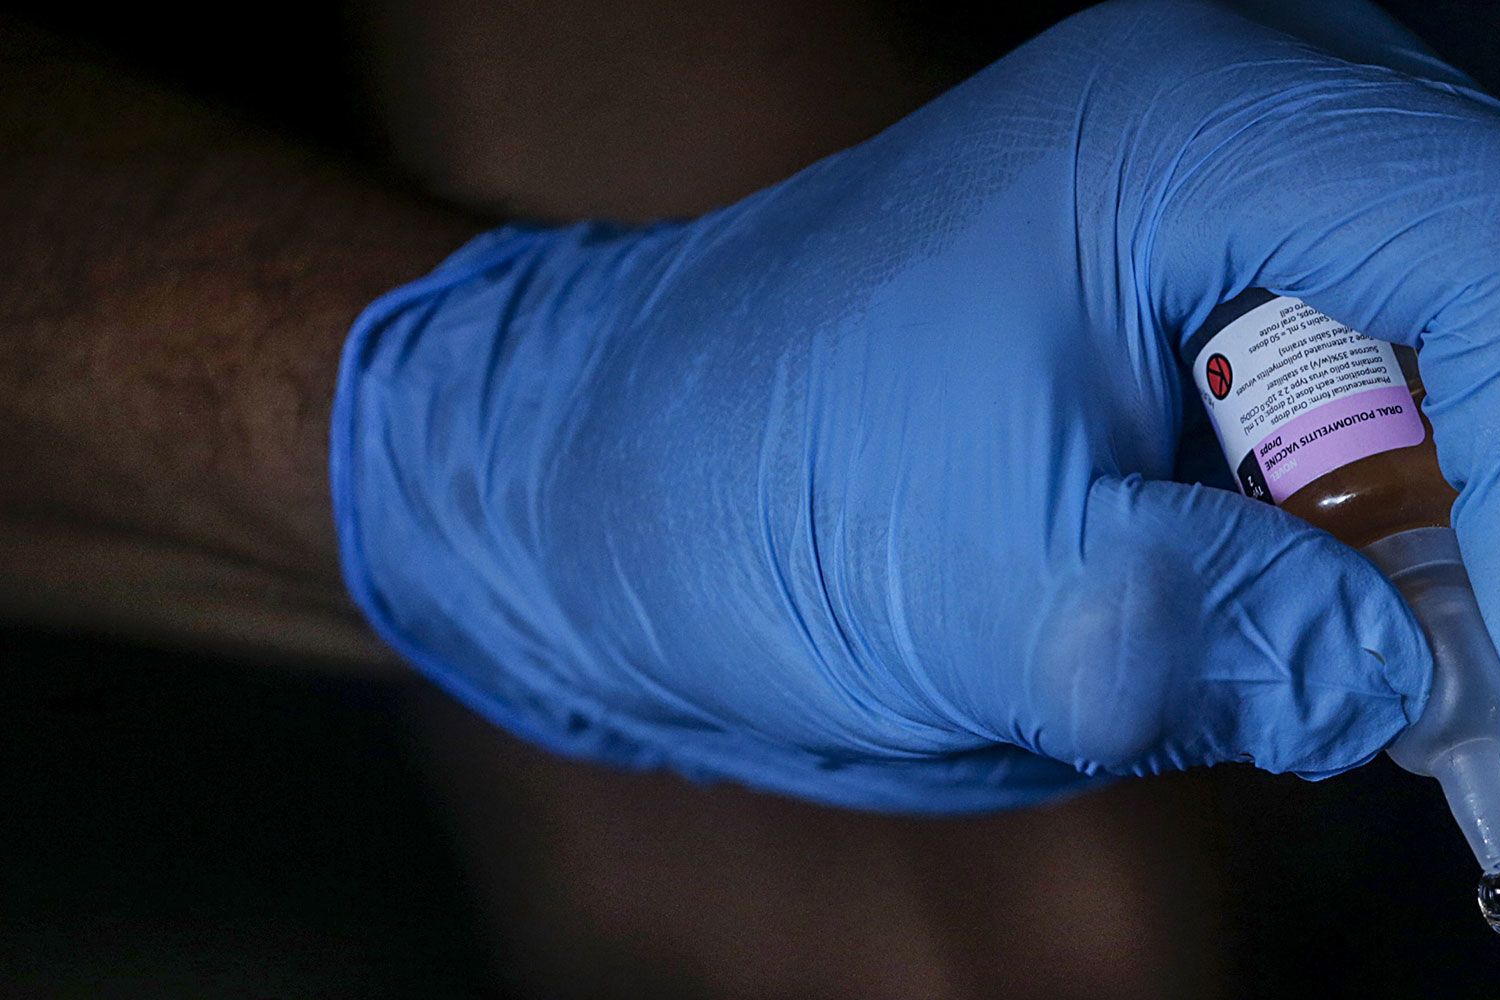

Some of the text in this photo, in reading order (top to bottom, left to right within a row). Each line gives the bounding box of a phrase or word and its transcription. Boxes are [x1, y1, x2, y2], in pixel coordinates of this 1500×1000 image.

[1280, 306, 1293, 318] cell
[1280, 315, 1296, 328] oral
[1300, 321, 1307, 330] 5
[1306, 314, 1330, 326] Sabin
[1259, 322, 1280, 337] route
[1285, 324, 1299, 334] mL
[1269, 332, 1280, 343] 50
[1308, 330, 1331, 342] Sabin
[1349, 336, 1355, 344] 2
[1248, 338, 1269, 354] doses
[1278, 339, 1307, 357] strains)
[1303, 337, 1348, 358] attenuated
[1256, 350, 1303, 380] poliomyelitis
[1267, 345, 1379, 390] Sucrose 35%(w/v) as stabilizer
[1329, 361, 1350, 373] polio
[1351, 356, 1383, 368] contains
[1309, 369, 1329, 381] virus
[1336, 366, 1387, 381] Composition:
[1236, 378, 1257, 396] viruses
[1290, 377, 1308, 390] type
[1316, 378, 1335, 391] each
[1283, 386, 1290, 395] 2
[1295, 386, 1314, 399] dose
[1270, 376, 1391, 425] Pharmaceutical form: Oral drops
[1286, 395, 1295, 405] (2
[1264, 405, 1403, 471] ORAL POLIOMYELITIS VACCINE
[1260, 435, 1282, 457] Drops
[1270, 459, 1297, 481] NOVEL
[1247, 475, 1254, 487] 2
